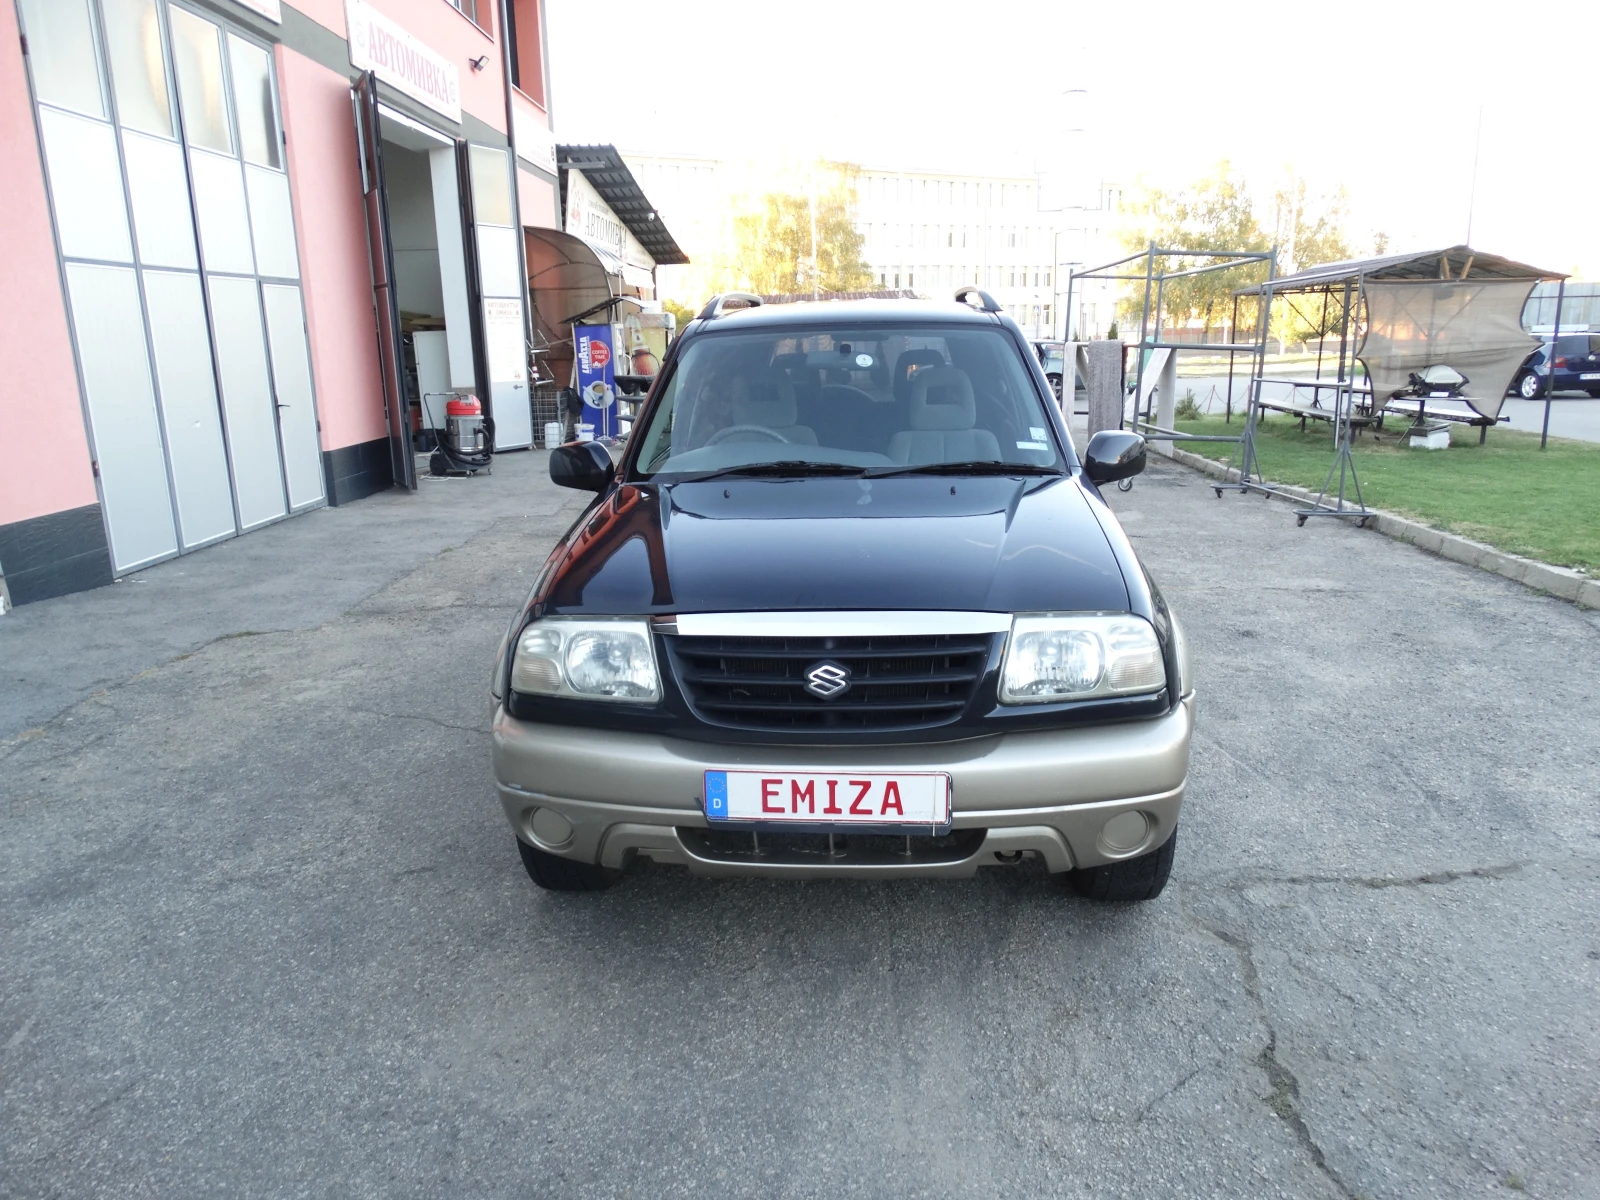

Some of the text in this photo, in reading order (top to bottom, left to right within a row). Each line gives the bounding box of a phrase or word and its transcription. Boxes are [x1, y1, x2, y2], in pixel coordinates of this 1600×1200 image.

[368, 20, 449, 105] АВТОМИВКА
[578, 336, 590, 375] LAVAZZA
[712, 778, 904, 816] D EMIZA
